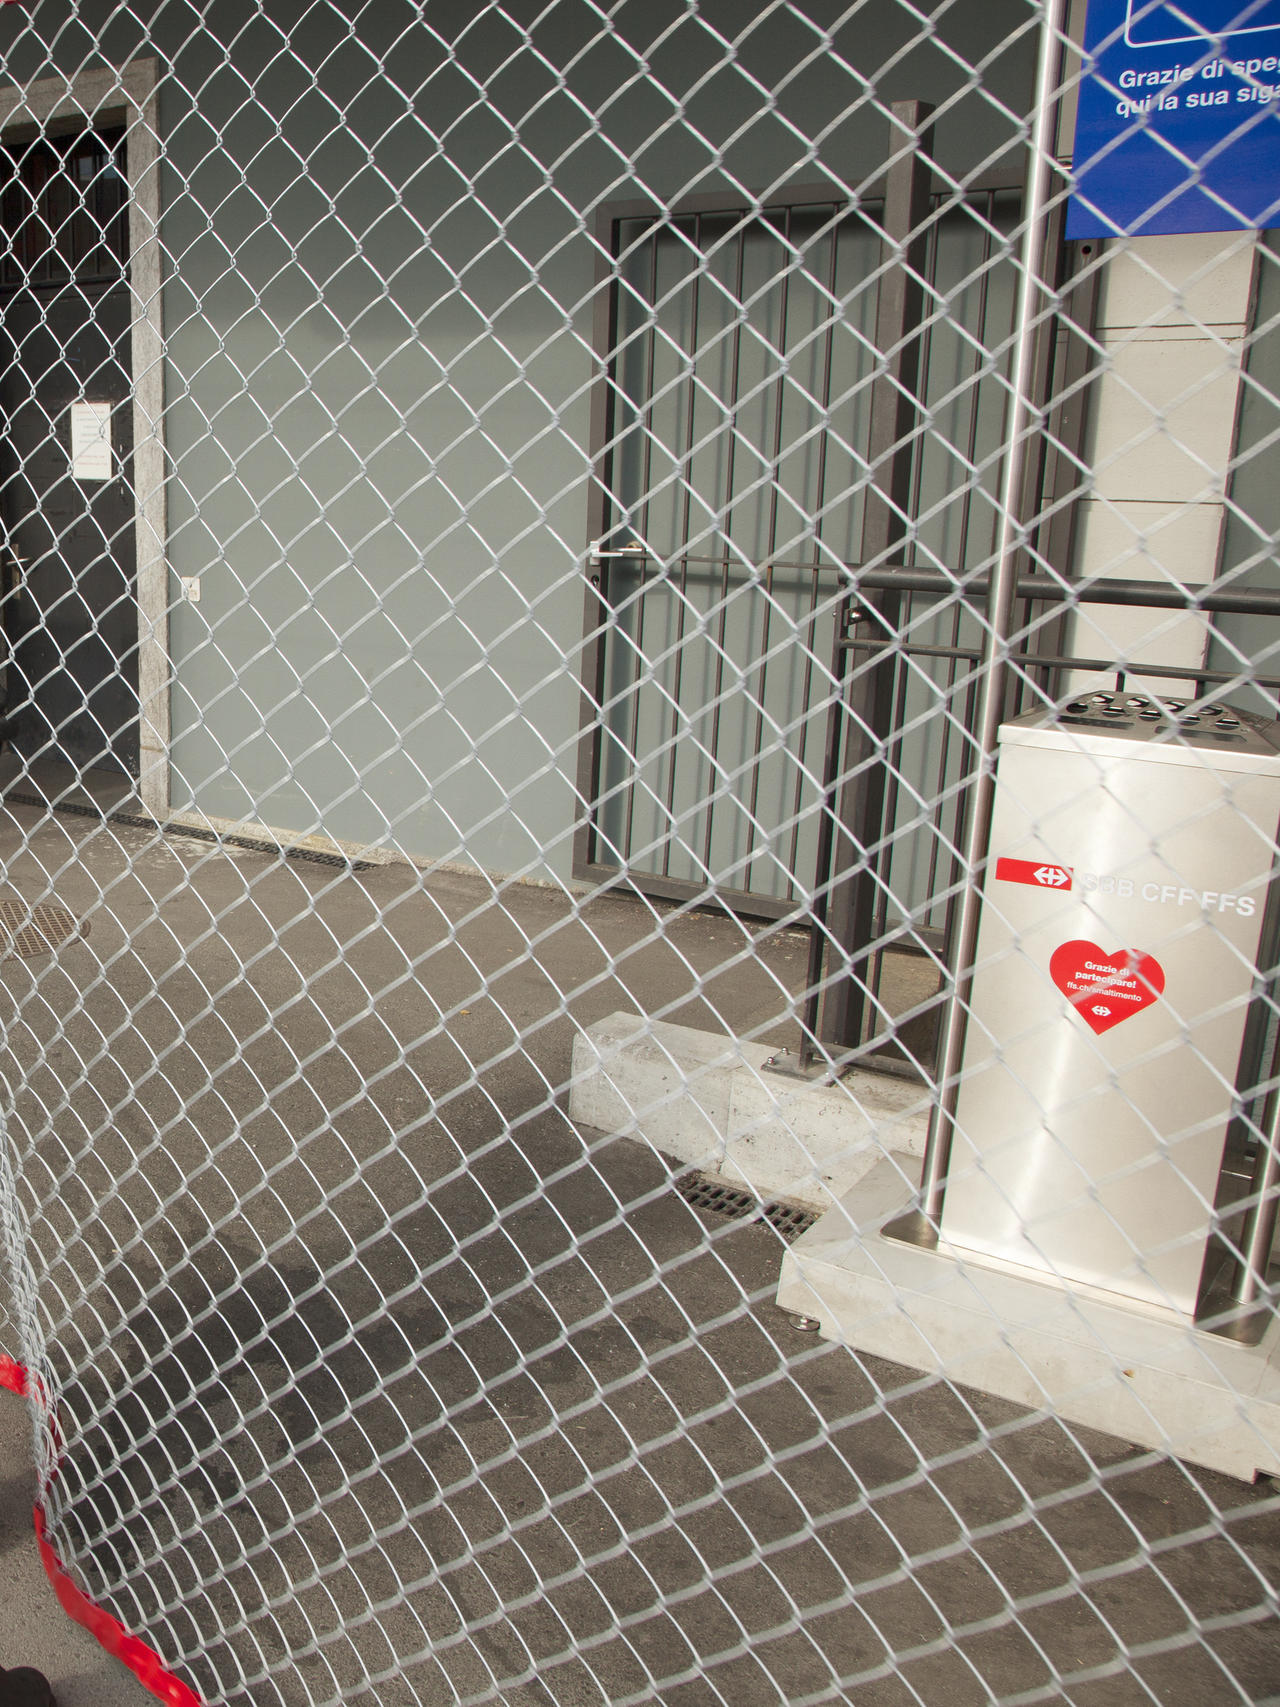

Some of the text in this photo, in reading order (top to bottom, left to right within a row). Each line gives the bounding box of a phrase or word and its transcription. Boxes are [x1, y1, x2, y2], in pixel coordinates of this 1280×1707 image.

[1119, 56, 1280, 89] Grazie di spe
[1116, 95, 1151, 118] qui
[1158, 93, 1178, 111] la
[1185, 90, 1229, 107] sua
[1081, 873, 1256, 917] SBB CFF FFS
[1075, 971, 1137, 989] partecipare!
[1084, 961, 1130, 977] Grazie di
[1066, 981, 1142, 1002] ffs.ch/smaltimento
